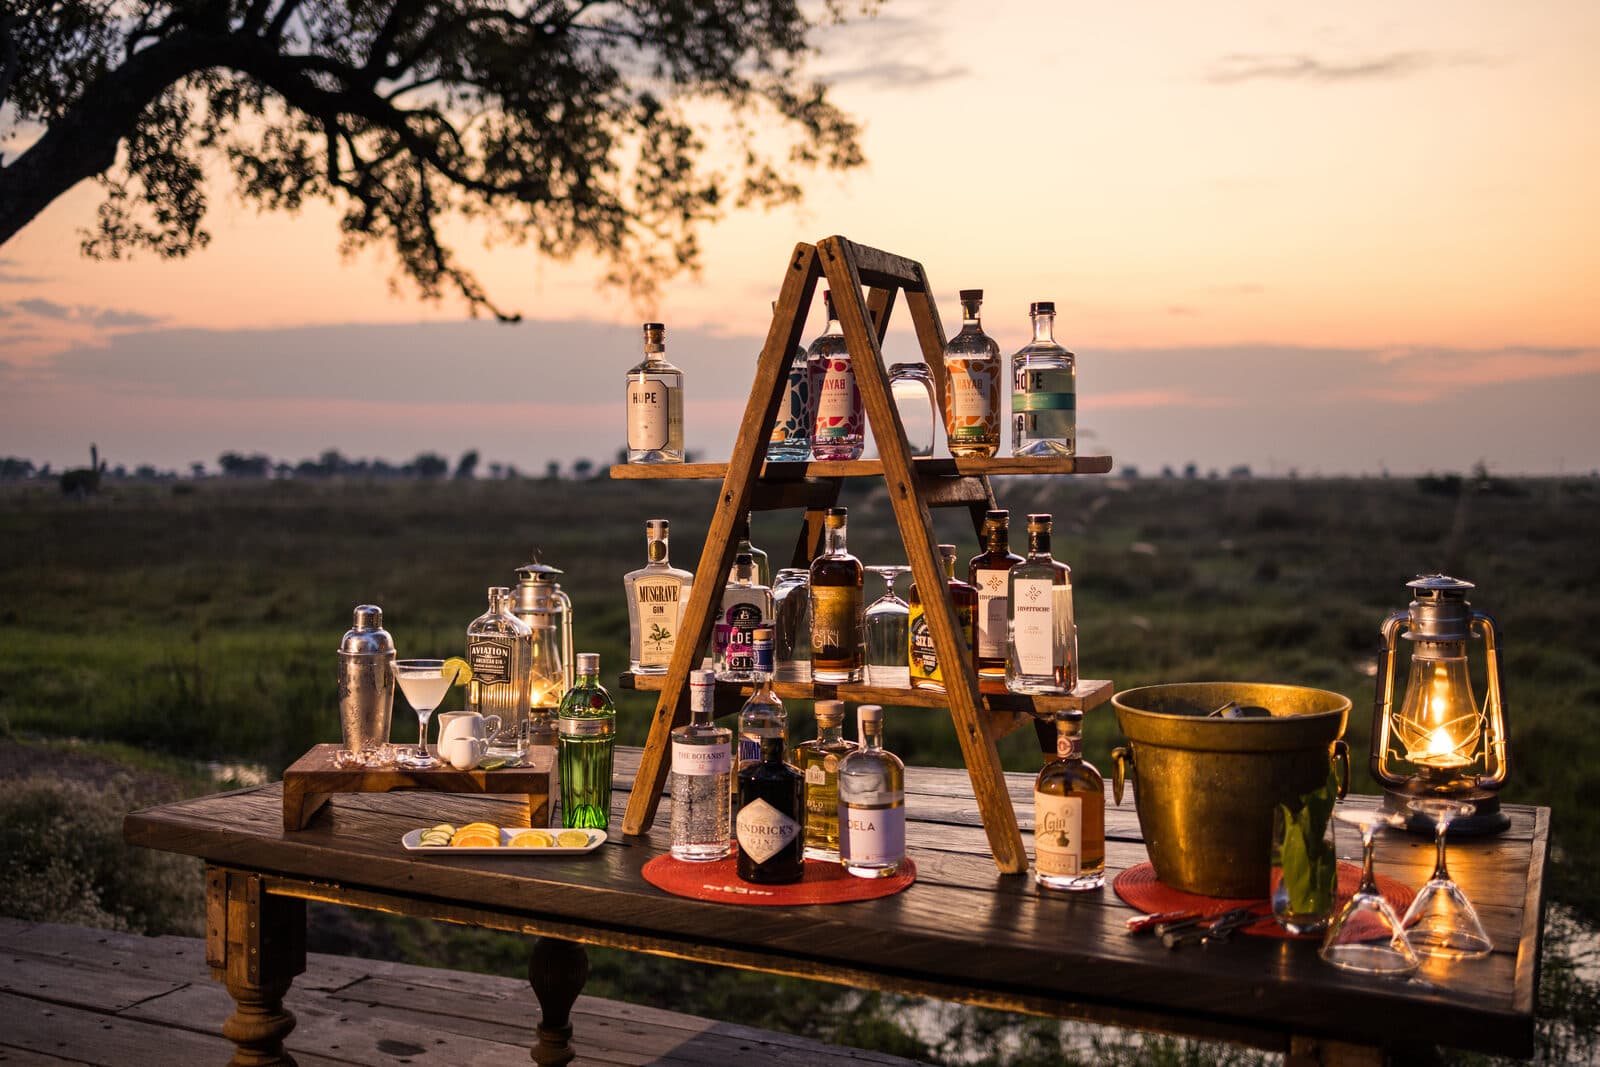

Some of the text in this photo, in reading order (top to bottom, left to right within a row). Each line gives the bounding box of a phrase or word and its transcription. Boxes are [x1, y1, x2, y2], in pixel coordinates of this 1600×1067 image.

[632, 392, 657, 404] HOPE
[639, 585, 678, 602] MUSGRAVE
[652, 606, 664, 614] GIN
[716, 631, 752, 644] WILDE
[812, 633, 839, 648] GIN
[471, 646, 508, 657] AVIATION
[678, 751, 725, 760] THE BOTANIST
